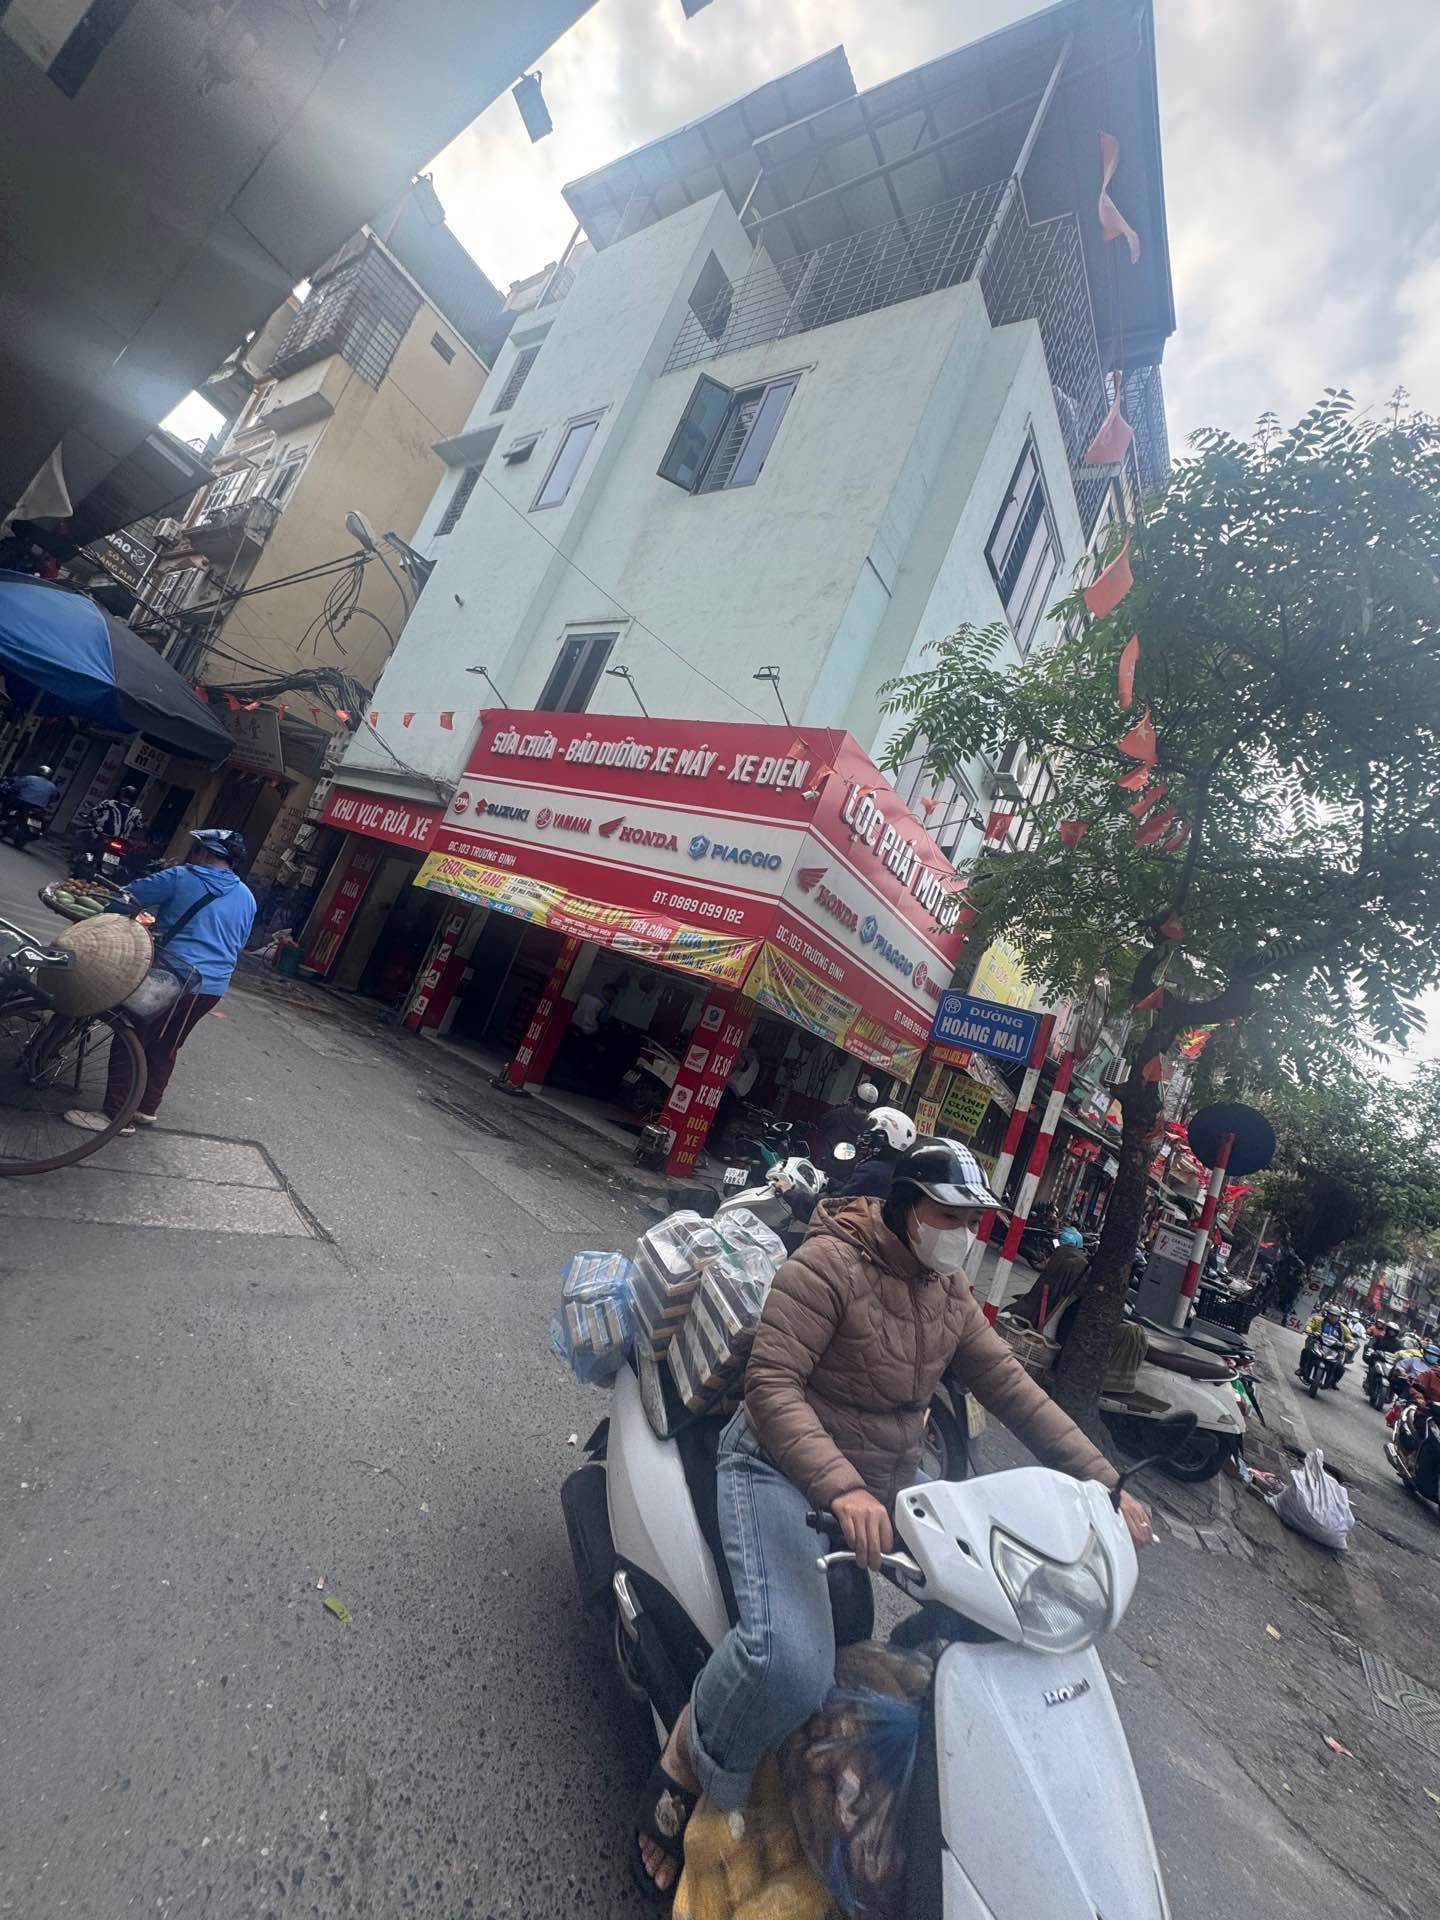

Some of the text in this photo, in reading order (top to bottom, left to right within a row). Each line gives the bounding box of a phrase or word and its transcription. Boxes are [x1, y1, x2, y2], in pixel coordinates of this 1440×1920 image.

[491, 725, 520, 755] SỬA
[518, 729, 558, 760] CHỮA
[564, 732, 600, 764] BẢO
[595, 736, 653, 771] DƯỠNG
[650, 746, 678, 773] XE
[674, 744, 718, 778] MÁY
[727, 753, 760, 783] XE
[755, 757, 810, 793] ĐIỆN
[331, 797, 354, 820] KHU
[356, 803, 379, 831] VỰC
[380, 805, 408, 836] RỬA
[409, 816, 433, 841] XE
[486, 803, 530, 823] SUZUKI
[553, 813, 592, 834] YAMAHA
[619, 826, 679, 852] HONDA
[711, 843, 782, 870] PIAGGIO
[880, 825, 921, 887] PHÁT
[331, 908, 345, 924] XE
[669, 894, 698, 913] 0889
[699, 902, 724, 919] 099
[723, 907, 745, 925] 182
[814, 885, 859, 934] HONDA
[872, 934, 914, 976] PIAGGIO
[969, 1006, 1024, 1029] ĐƯỜNG
[940, 1015, 1025, 1054] HOÀNG MAI
[687, 1114, 709, 1132] RỬA
[684, 1134, 700, 1148] XE
[676, 1151, 697, 1165] 10K
